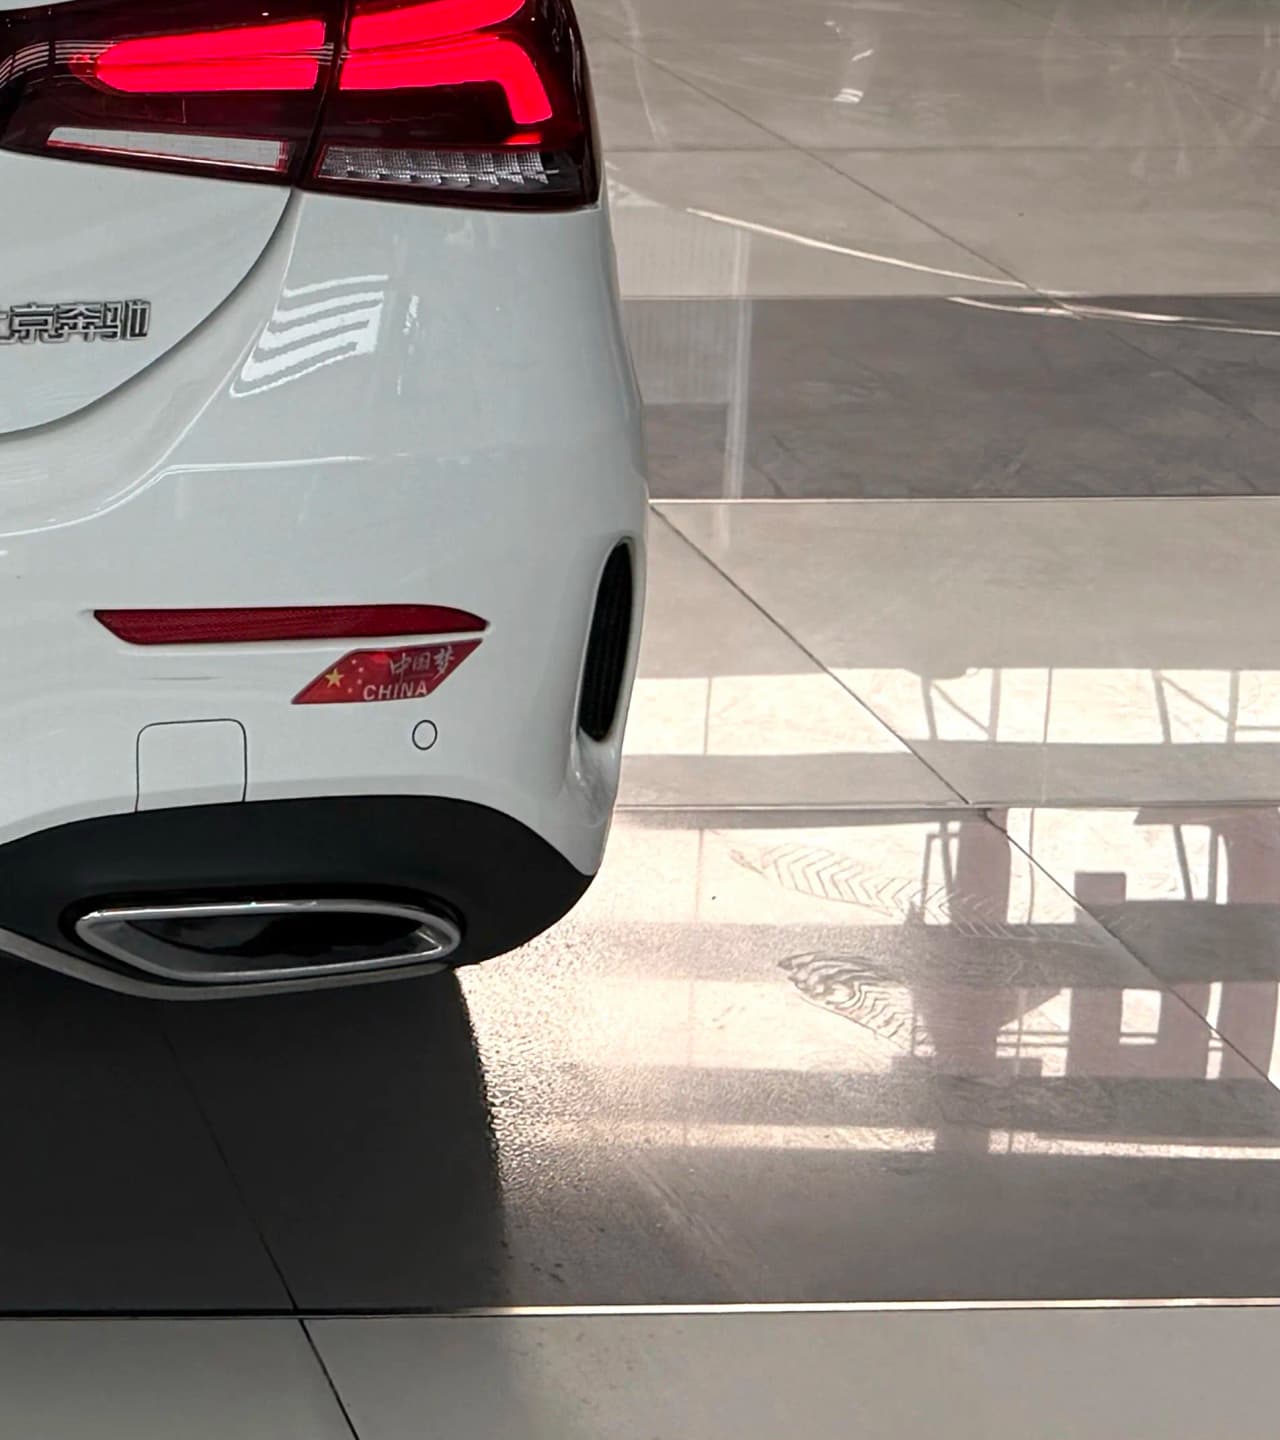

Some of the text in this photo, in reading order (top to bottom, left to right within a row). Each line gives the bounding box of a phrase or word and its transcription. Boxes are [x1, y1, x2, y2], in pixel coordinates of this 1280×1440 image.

[389, 645, 456, 684] 中国梦
[362, 680, 429, 701] CHINA
